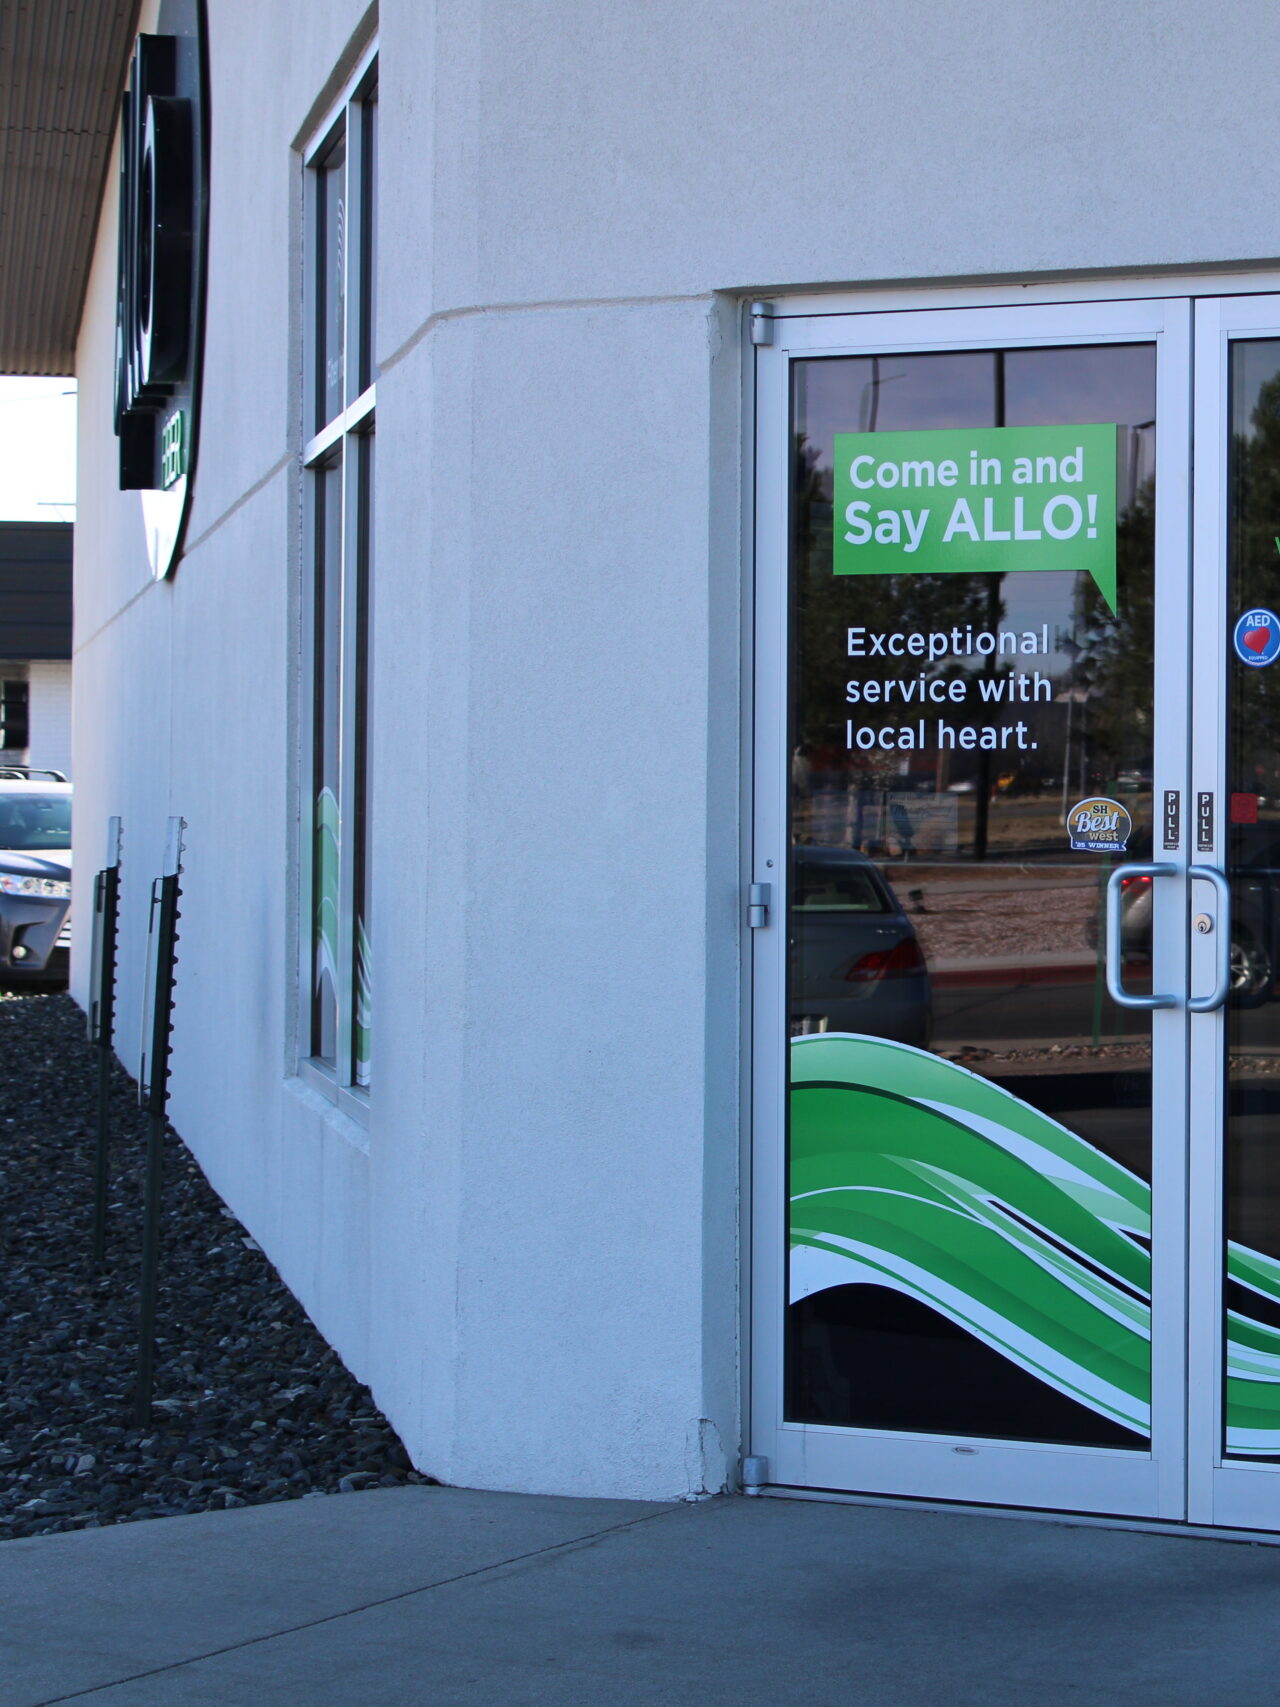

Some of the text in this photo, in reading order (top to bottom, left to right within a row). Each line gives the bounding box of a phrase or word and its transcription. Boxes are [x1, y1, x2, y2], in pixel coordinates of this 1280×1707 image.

[850, 446, 1083, 488] Come in and
[845, 494, 1097, 552] Say ALLO!
[1246, 615, 1270, 627] AED
[847, 622, 1049, 661] Exceptional
[846, 672, 1052, 702] service with
[846, 719, 1038, 750] local heart.
[1075, 811, 1119, 833] Best
[1092, 805, 1108, 814] SH
[1167, 792, 1177, 840] PULL
[1200, 794, 1210, 842] PULL
[1089, 831, 1119, 841] west
